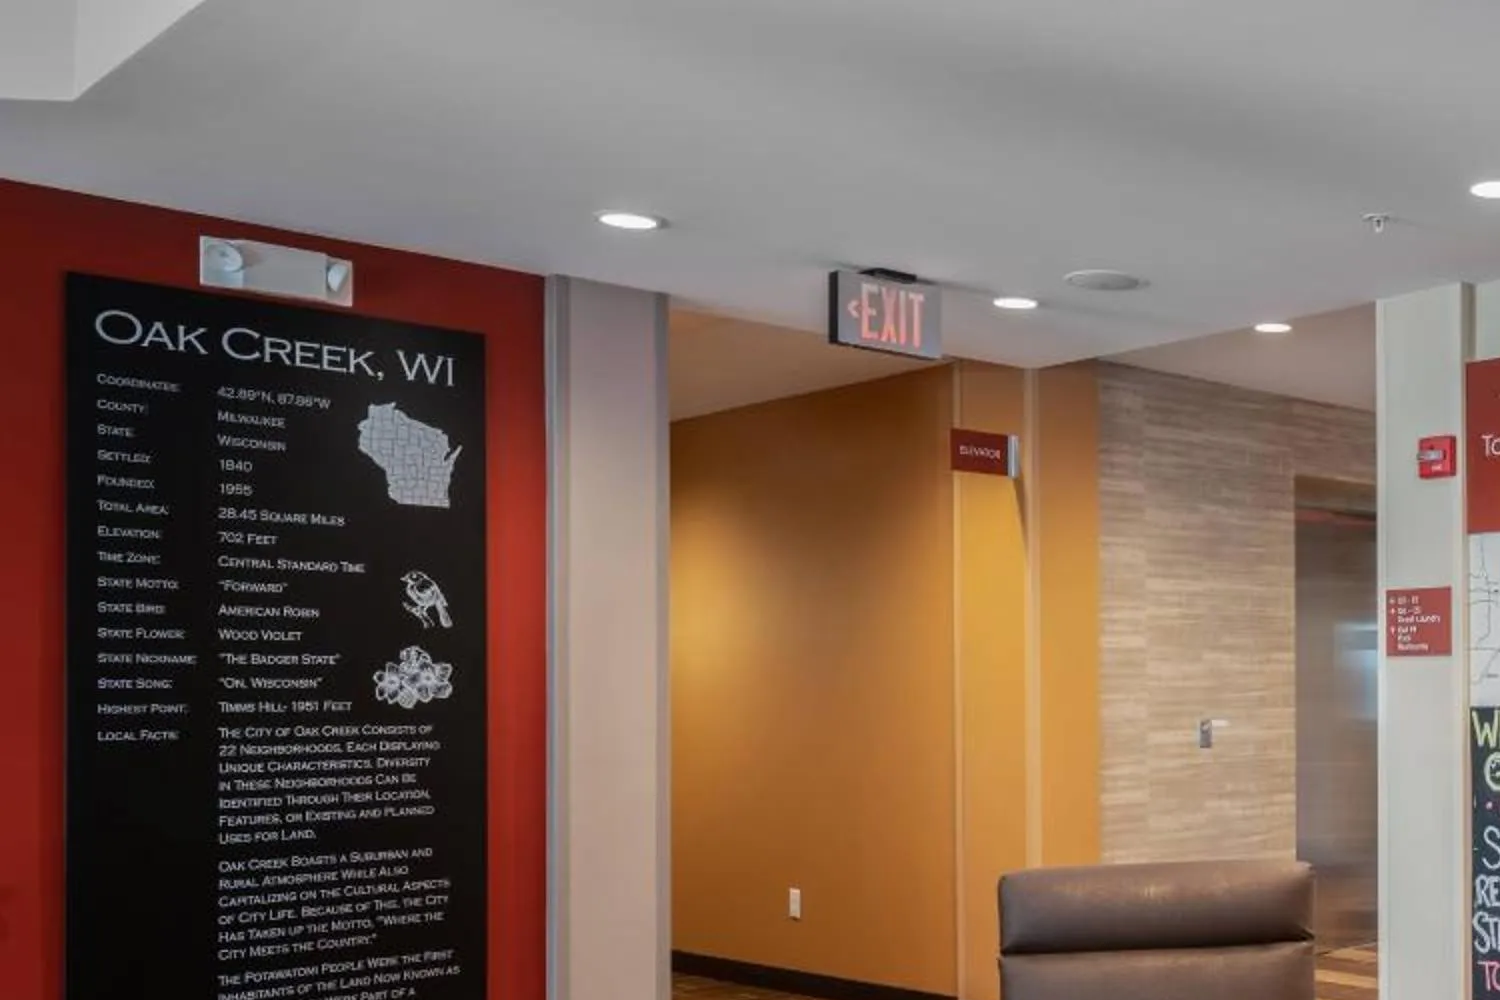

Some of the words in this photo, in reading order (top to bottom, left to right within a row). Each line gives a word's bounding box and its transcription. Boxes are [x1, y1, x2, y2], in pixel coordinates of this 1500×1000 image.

[861, 283, 924, 347] EXIT
[95, 306, 208, 357] OAK
[222, 324, 385, 379] CREEK,
[397, 349, 454, 388] WI
[218, 458, 252, 472] 1840
[218, 531, 244, 543] 702
[247, 533, 278, 545] FEET
[217, 555, 274, 569] CENTRAL
[277, 558, 337, 572] STANDARD
[96, 576, 132, 588] STATE
[96, 602, 132, 613] STATE
[217, 604, 280, 617] AMERICAN
[96, 627, 132, 638] STATE
[217, 628, 258, 640] WOOD
[260, 629, 303, 641] VIOLET
[96, 653, 132, 664] STATE
[250, 653, 298, 665] BADGER
[96, 678, 132, 689] STATE
[218, 727, 240, 738] THE
[244, 726, 272, 738] CITY
[274, 726, 290, 737] OF
[293, 726, 318, 737] OAK
[321, 725, 359, 736] CREEK
[219, 744, 236, 756] 22
[346, 741, 377, 753] EACH
[218, 761, 264, 774] UNIQUE
[376, 756, 431, 768] DIVERSITY
[374, 773, 398, 785] CAN
[218, 859, 245, 873] OAK
[238, 911, 266, 923] CITY
[218, 947, 246, 960] CITY
